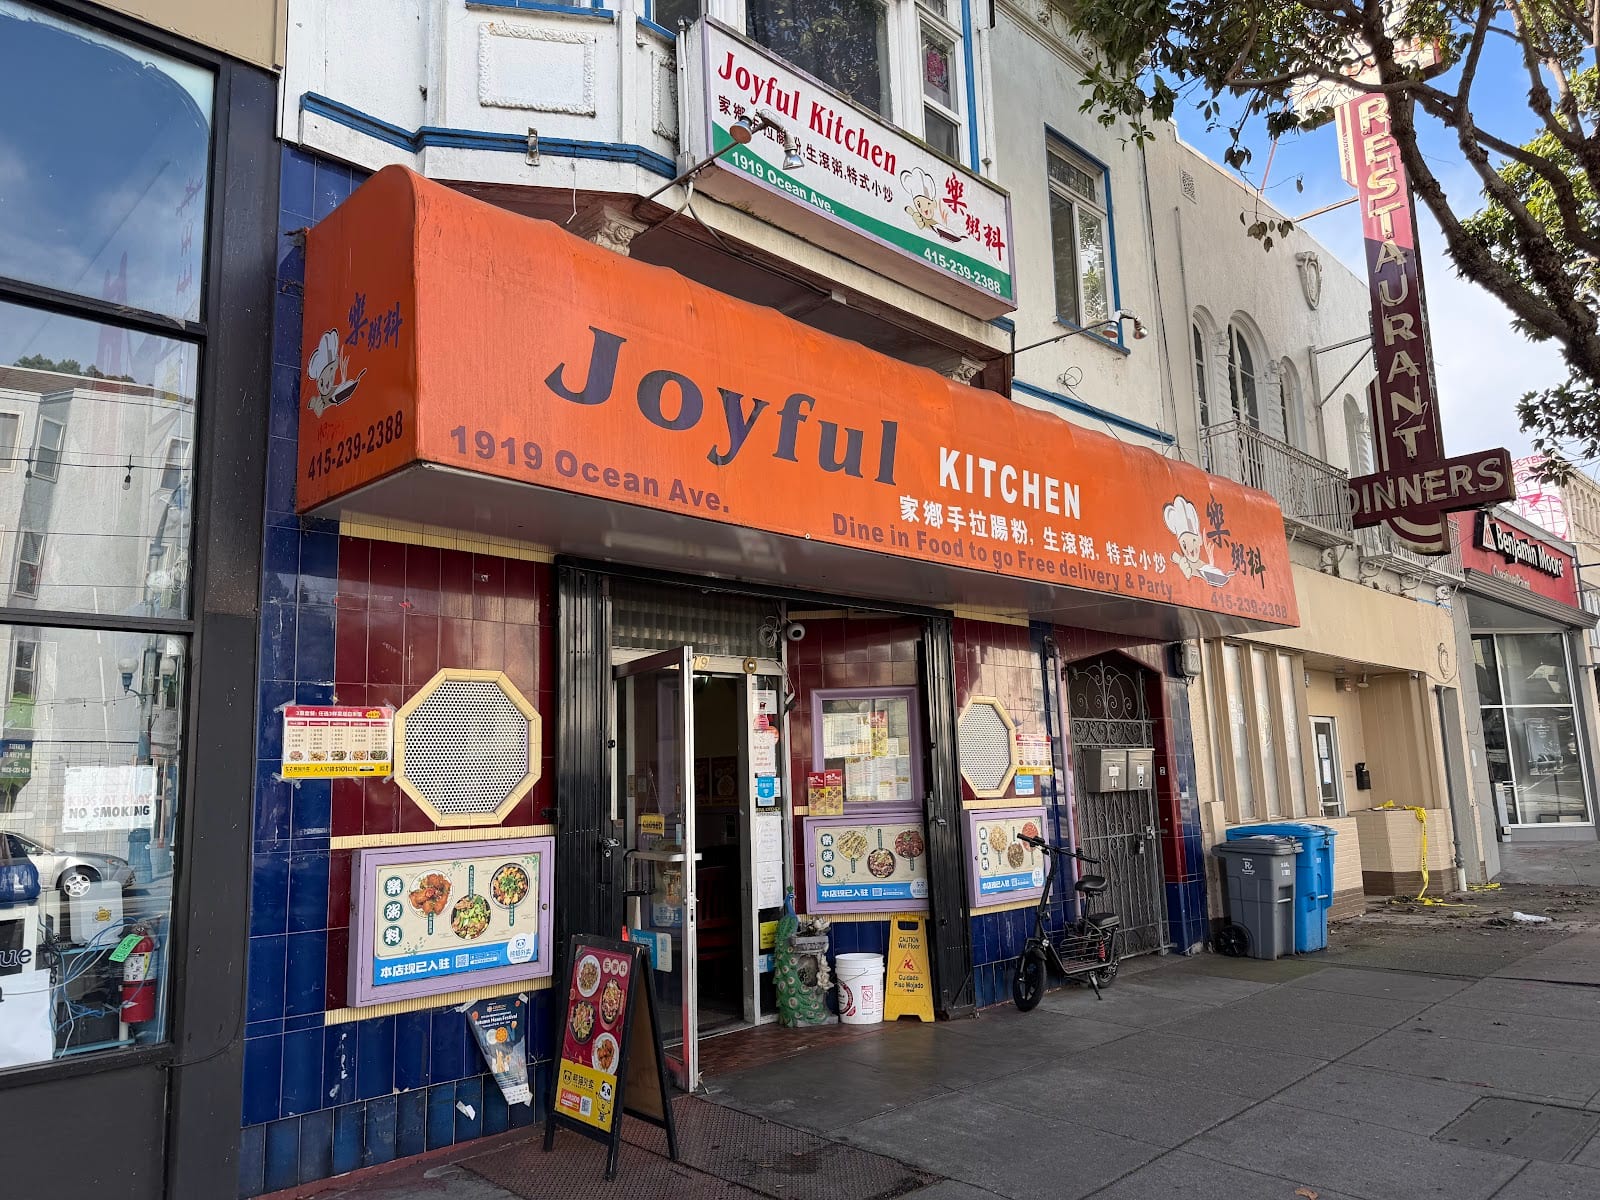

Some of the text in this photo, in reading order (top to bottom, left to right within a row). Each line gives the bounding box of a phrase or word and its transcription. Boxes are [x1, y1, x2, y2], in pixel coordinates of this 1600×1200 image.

[718, 51, 897, 176] Joyful Kitchen
[731, 151, 836, 215] 1919 Ocean Ave.
[923, 247, 1001, 294] 415-239-2388
[1358, 97, 1427, 460] RESTAURANT
[544, 326, 899, 486] Joyful
[308, 409, 404, 480] 415-239-2388
[450, 425, 730, 513] 1919 Ocean Ave.
[938, 445, 1081, 520] KITCHEN
[833, 512, 1174, 601] Dine in Food to go Free delivery & Party
[1496, 523, 1564, 577] Benjamin Moore
[1210, 590, 1288, 621] 415-239-2388
[69, 805, 150, 819] NO SMOKING
[380, 957, 450, 979] 本店现已入驻
